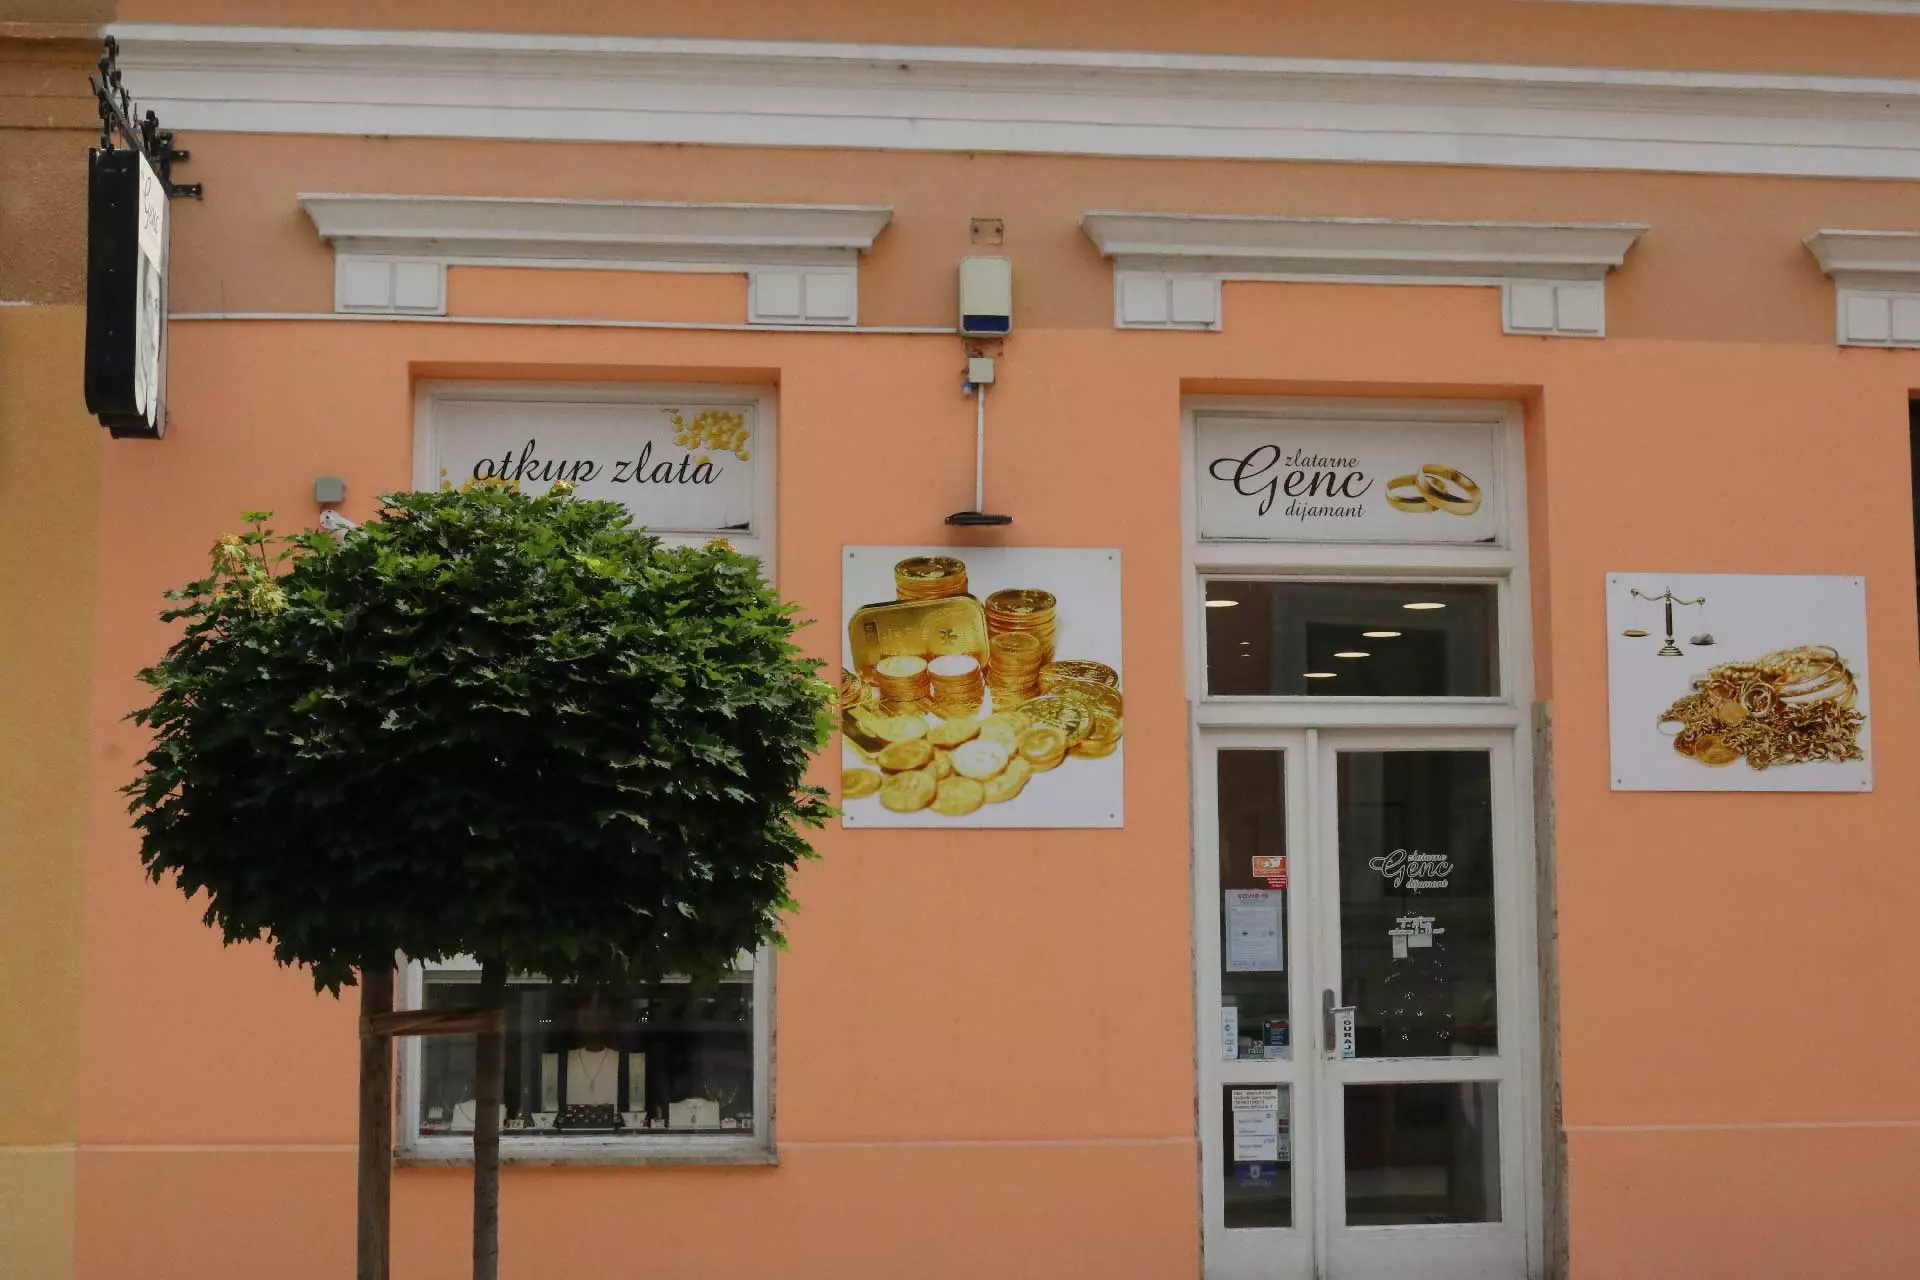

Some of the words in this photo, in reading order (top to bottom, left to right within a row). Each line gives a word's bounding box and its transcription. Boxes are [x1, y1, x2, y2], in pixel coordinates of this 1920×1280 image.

[473, 438, 604, 482] otkup
[611, 440, 724, 484] zlata
[1285, 448, 1360, 468] zlatarne
[1209, 444, 1374, 516] Genc
[1285, 498, 1366, 522] dijamant
[1368, 848, 1454, 888] Genc
